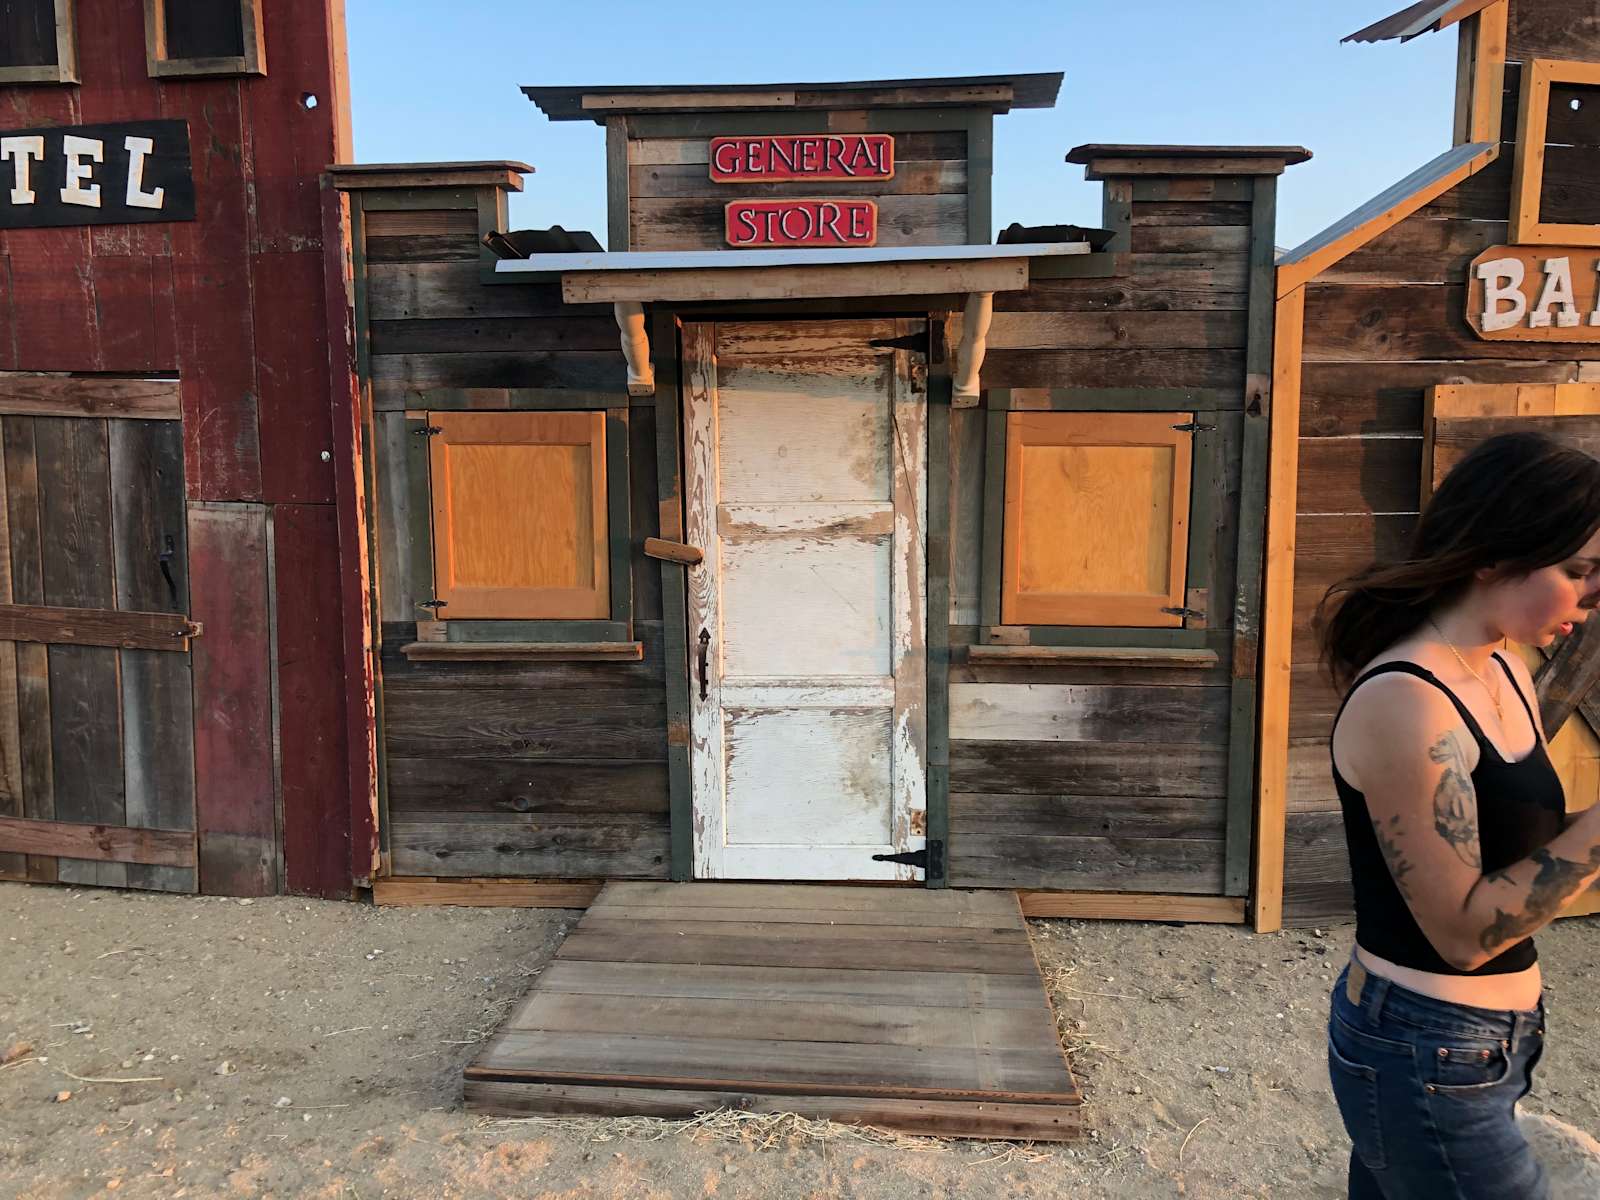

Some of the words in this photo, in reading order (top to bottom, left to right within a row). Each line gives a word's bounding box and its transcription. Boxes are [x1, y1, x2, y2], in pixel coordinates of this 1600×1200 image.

[0, 135, 164, 209] TEL
[736, 203, 870, 243] STORE
[1477, 257, 1600, 332] BA
